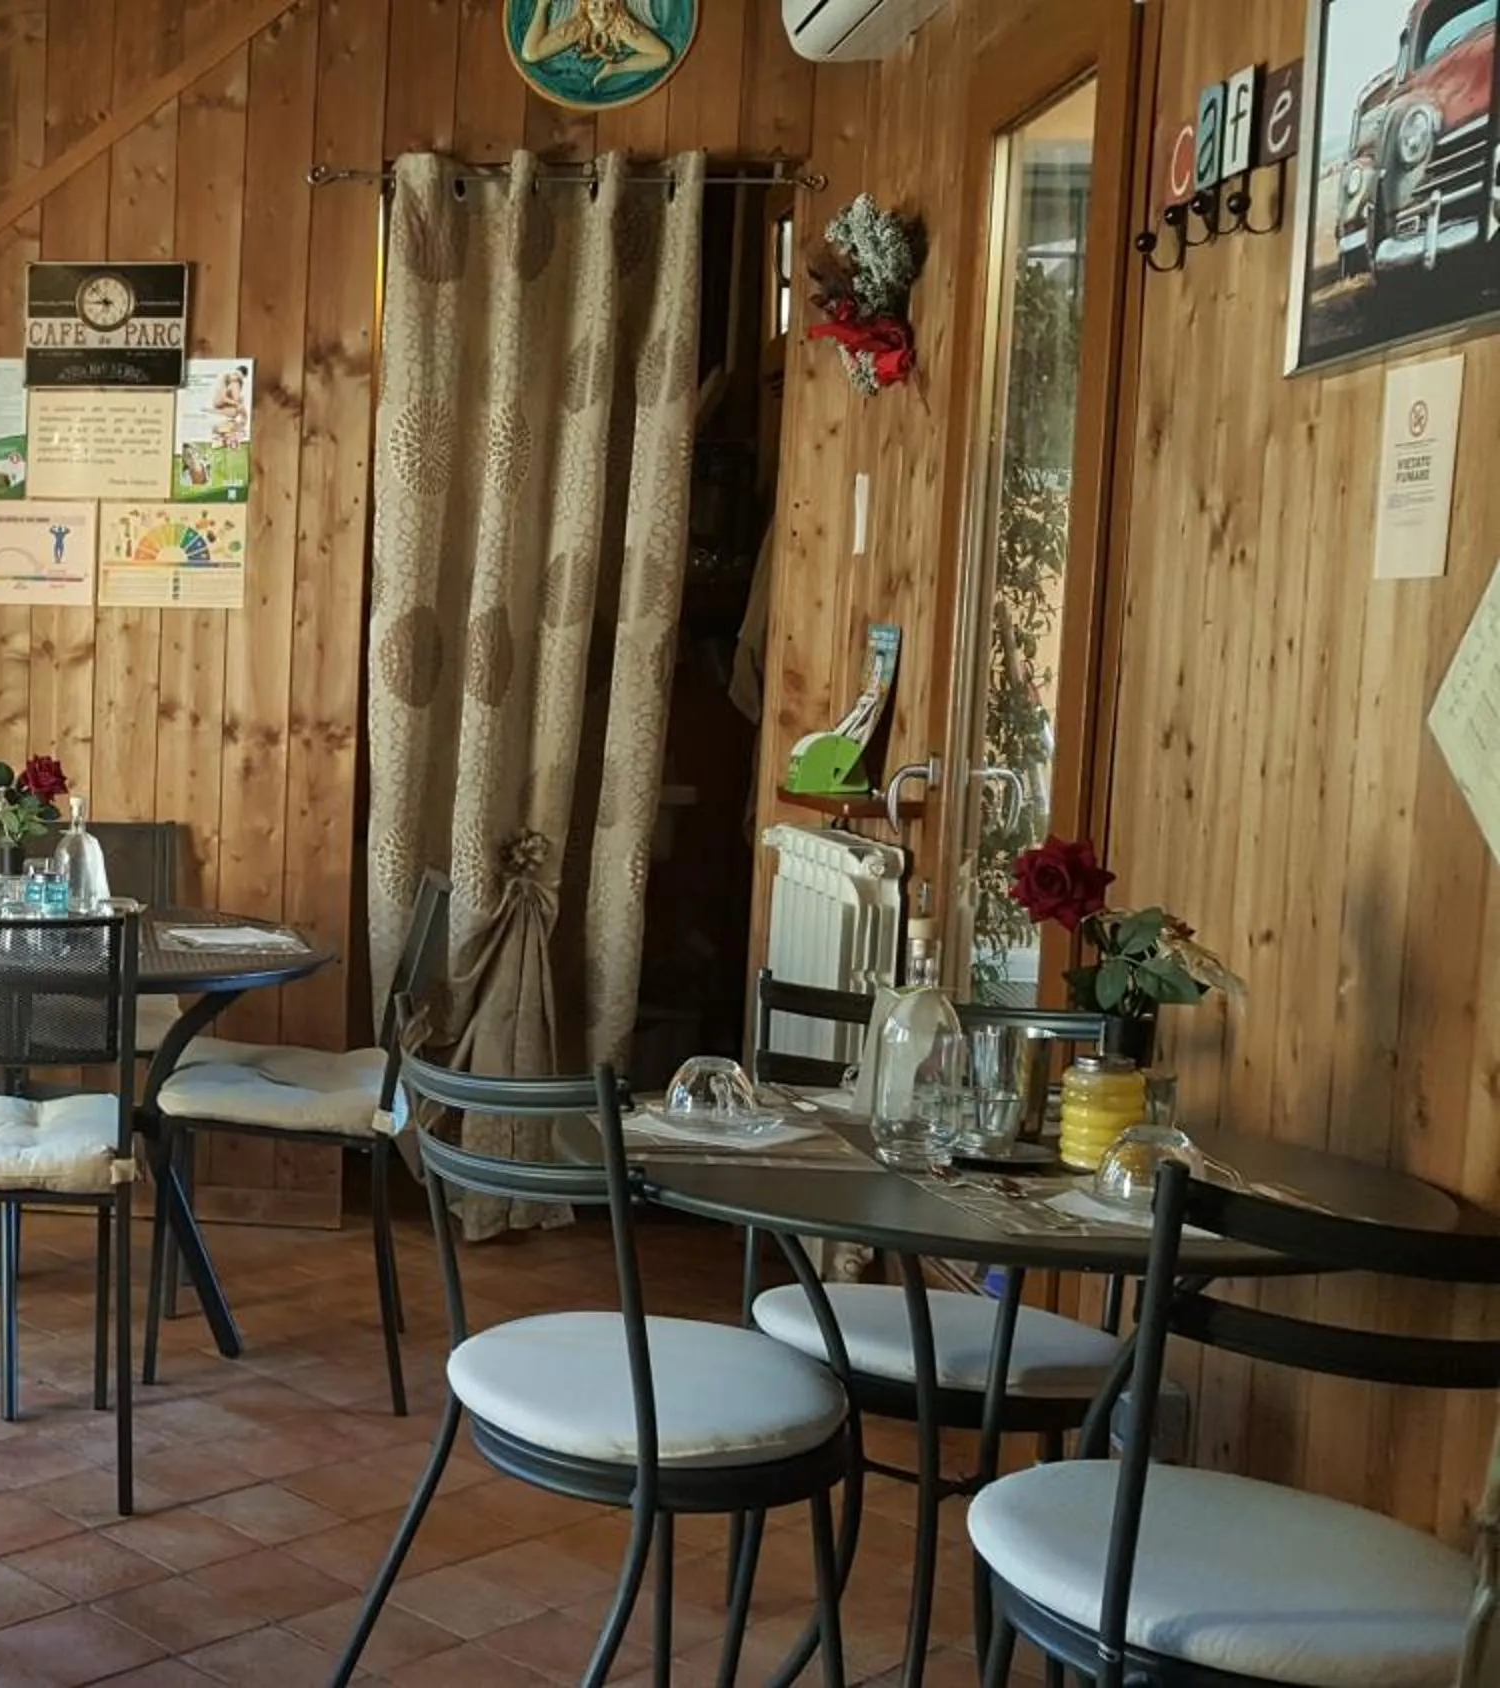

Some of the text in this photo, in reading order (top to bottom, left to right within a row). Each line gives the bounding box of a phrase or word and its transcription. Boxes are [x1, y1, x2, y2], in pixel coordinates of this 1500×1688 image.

[1171, 70, 1293, 196] café
[124, 321, 181, 346] PARC
[1397, 456, 1432, 472] VIETATO
[1396, 469, 1430, 483] FUMARE
